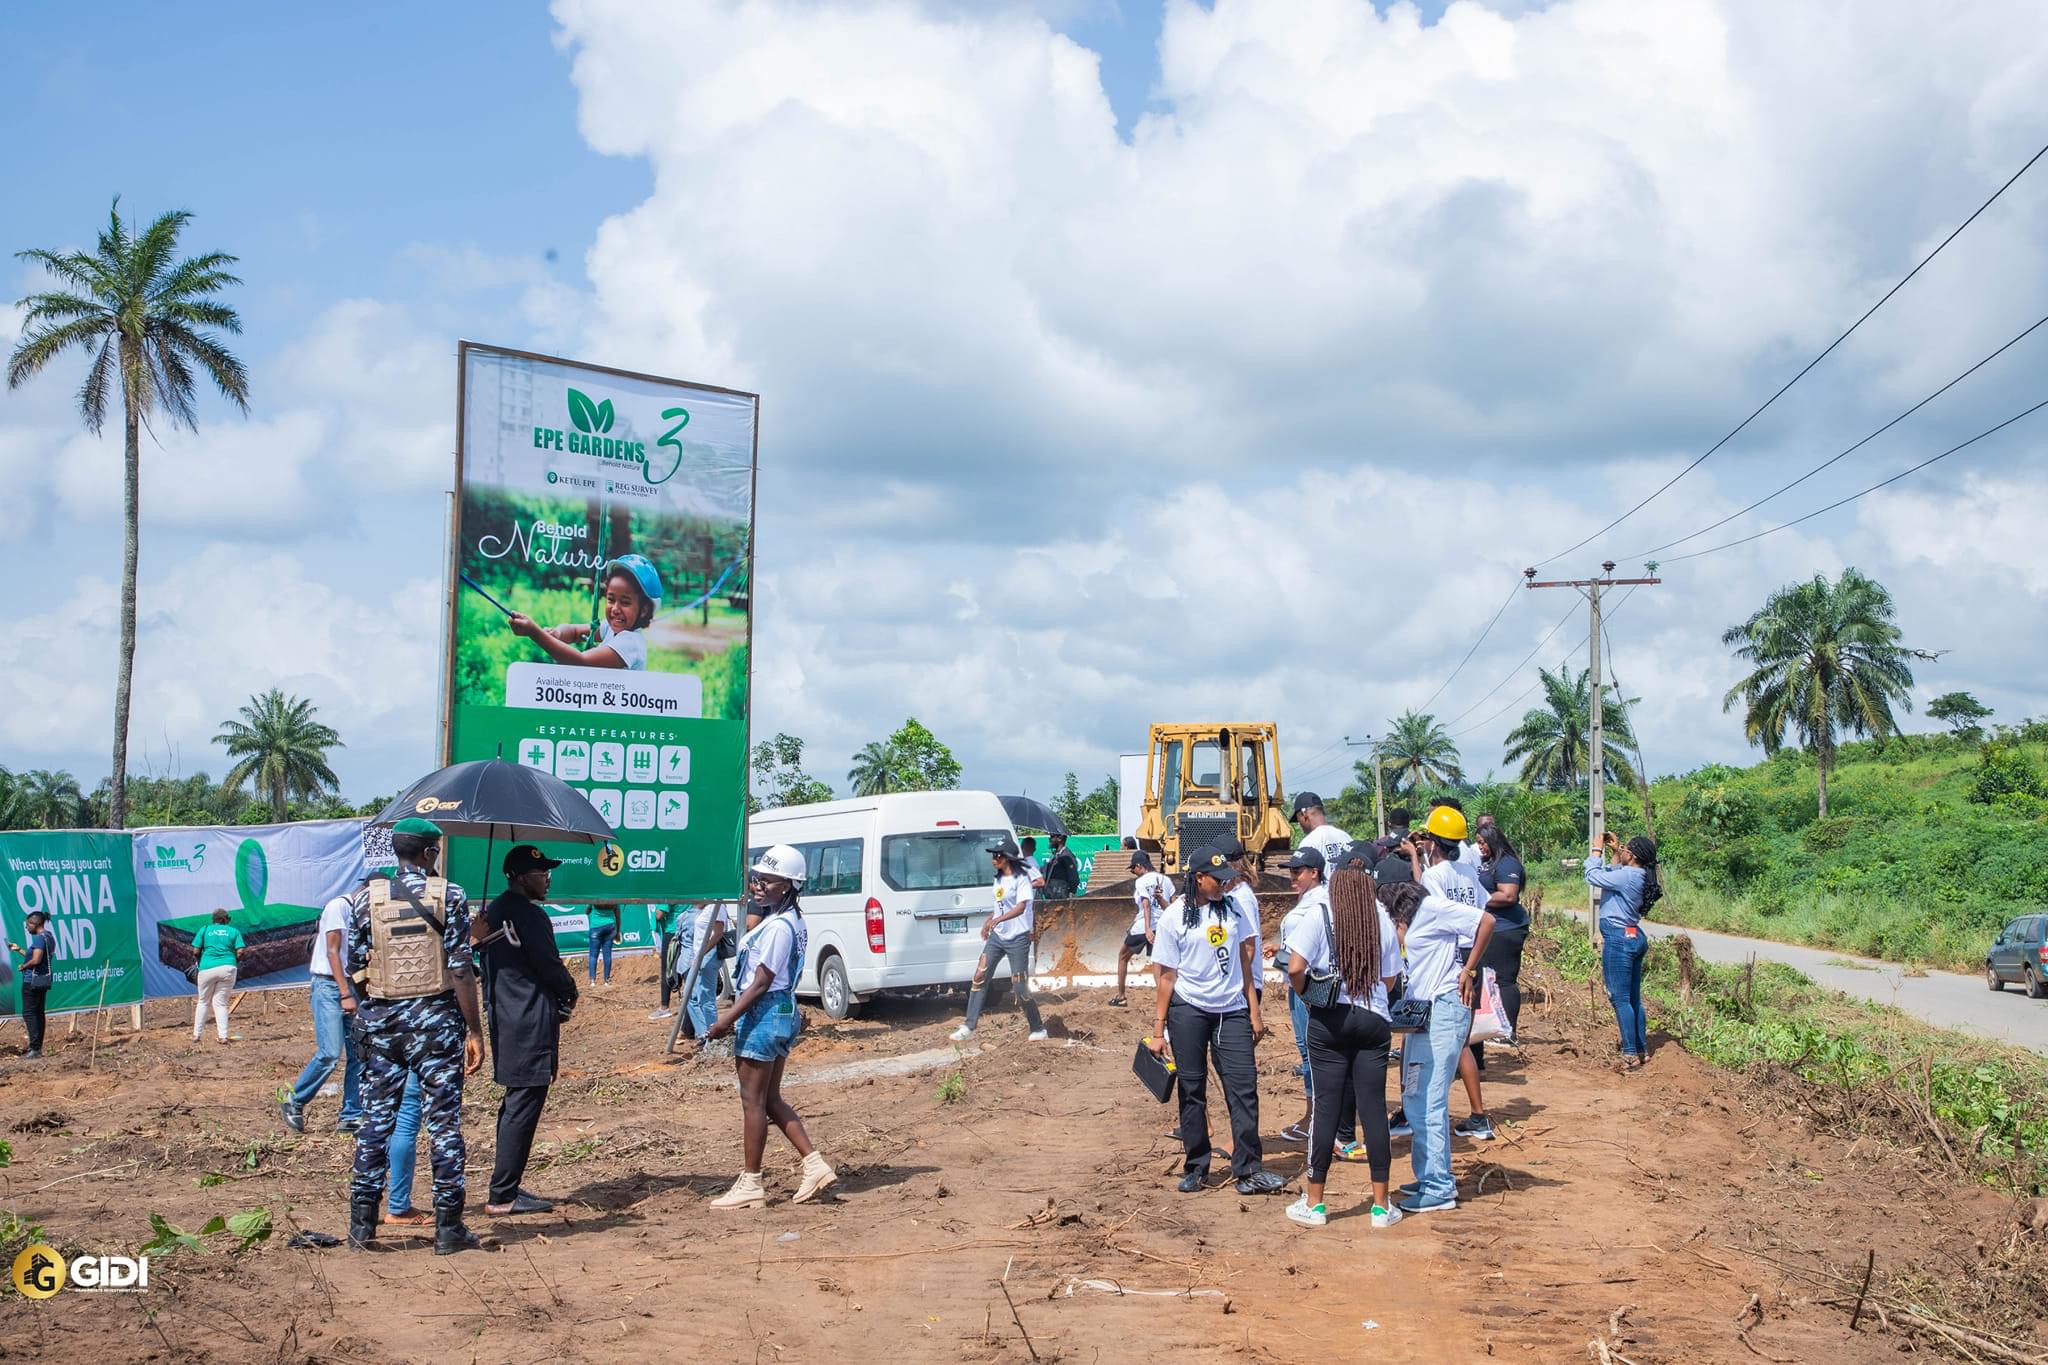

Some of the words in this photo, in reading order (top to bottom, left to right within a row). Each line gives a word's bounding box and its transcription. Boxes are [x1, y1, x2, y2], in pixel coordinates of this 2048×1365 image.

[534, 427, 563, 451] EPE
[568, 432, 646, 464] GARDENS
[641, 407, 690, 484] 3
[583, 478, 596, 488] EPE
[615, 481, 630, 491] REG
[631, 483, 658, 495] SURVEY
[536, 520, 587, 538] Behold
[479, 520, 609, 570] Nature
[536, 677, 571, 688] Available
[573, 680, 599, 690] square
[600, 682, 626, 690] meters
[535, 687, 597, 708] 300sqm
[602, 691, 616, 706] &
[621, 693, 678, 713] 500sqm
[539, 726, 595, 737] ESTATE
[601, 729, 674, 740] FEATURES
[1187, 811, 1226, 819] CATERPILLAR
[9, 857, 38, 871] When
[38, 857, 60, 873] they
[62, 860, 76, 872] say
[76, 859, 92, 872] you
[93, 857, 112, 870] can't
[157, 859, 189, 868] GARDENS
[584, 857, 593, 867] By:
[626, 850, 666, 869] GIDI
[16, 873, 94, 916] OWN
[97, 873, 117, 914] A
[623, 929, 641, 941] GIDI
[64, 967, 77, 981] and
[79, 966, 95, 980] take
